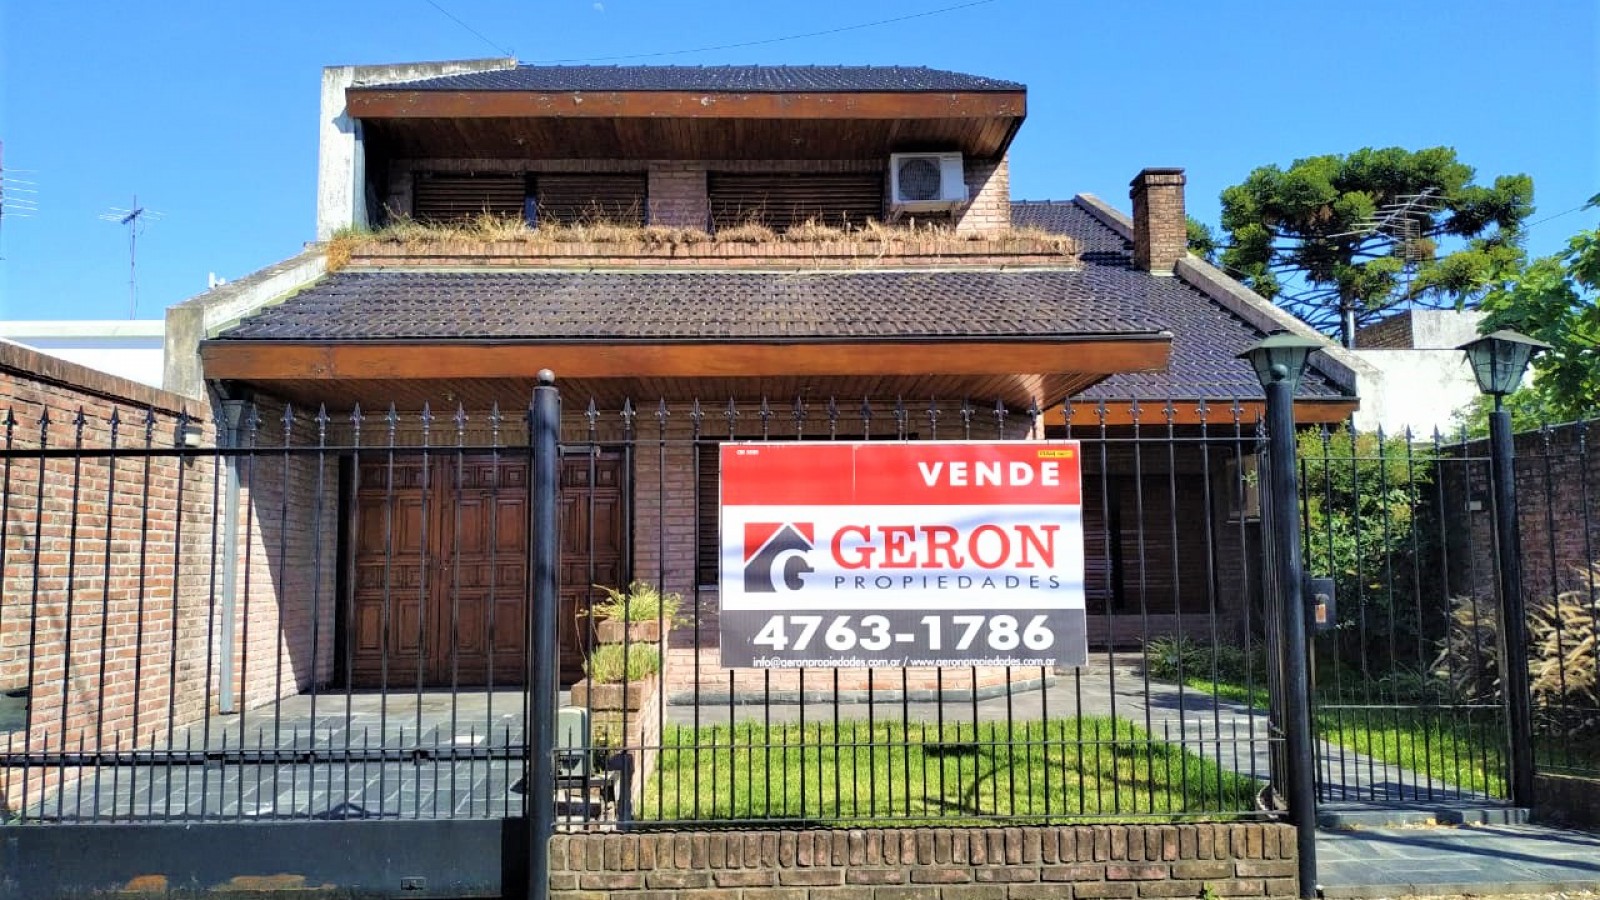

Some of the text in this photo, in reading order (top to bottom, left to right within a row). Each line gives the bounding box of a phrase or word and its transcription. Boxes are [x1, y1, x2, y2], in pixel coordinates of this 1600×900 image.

[918, 461, 1060, 487] VENDE
[830, 524, 1060, 570] GERON
[835, 575, 1060, 590] PROPIEDADES
[753, 614, 1055, 651] 4763-1786
